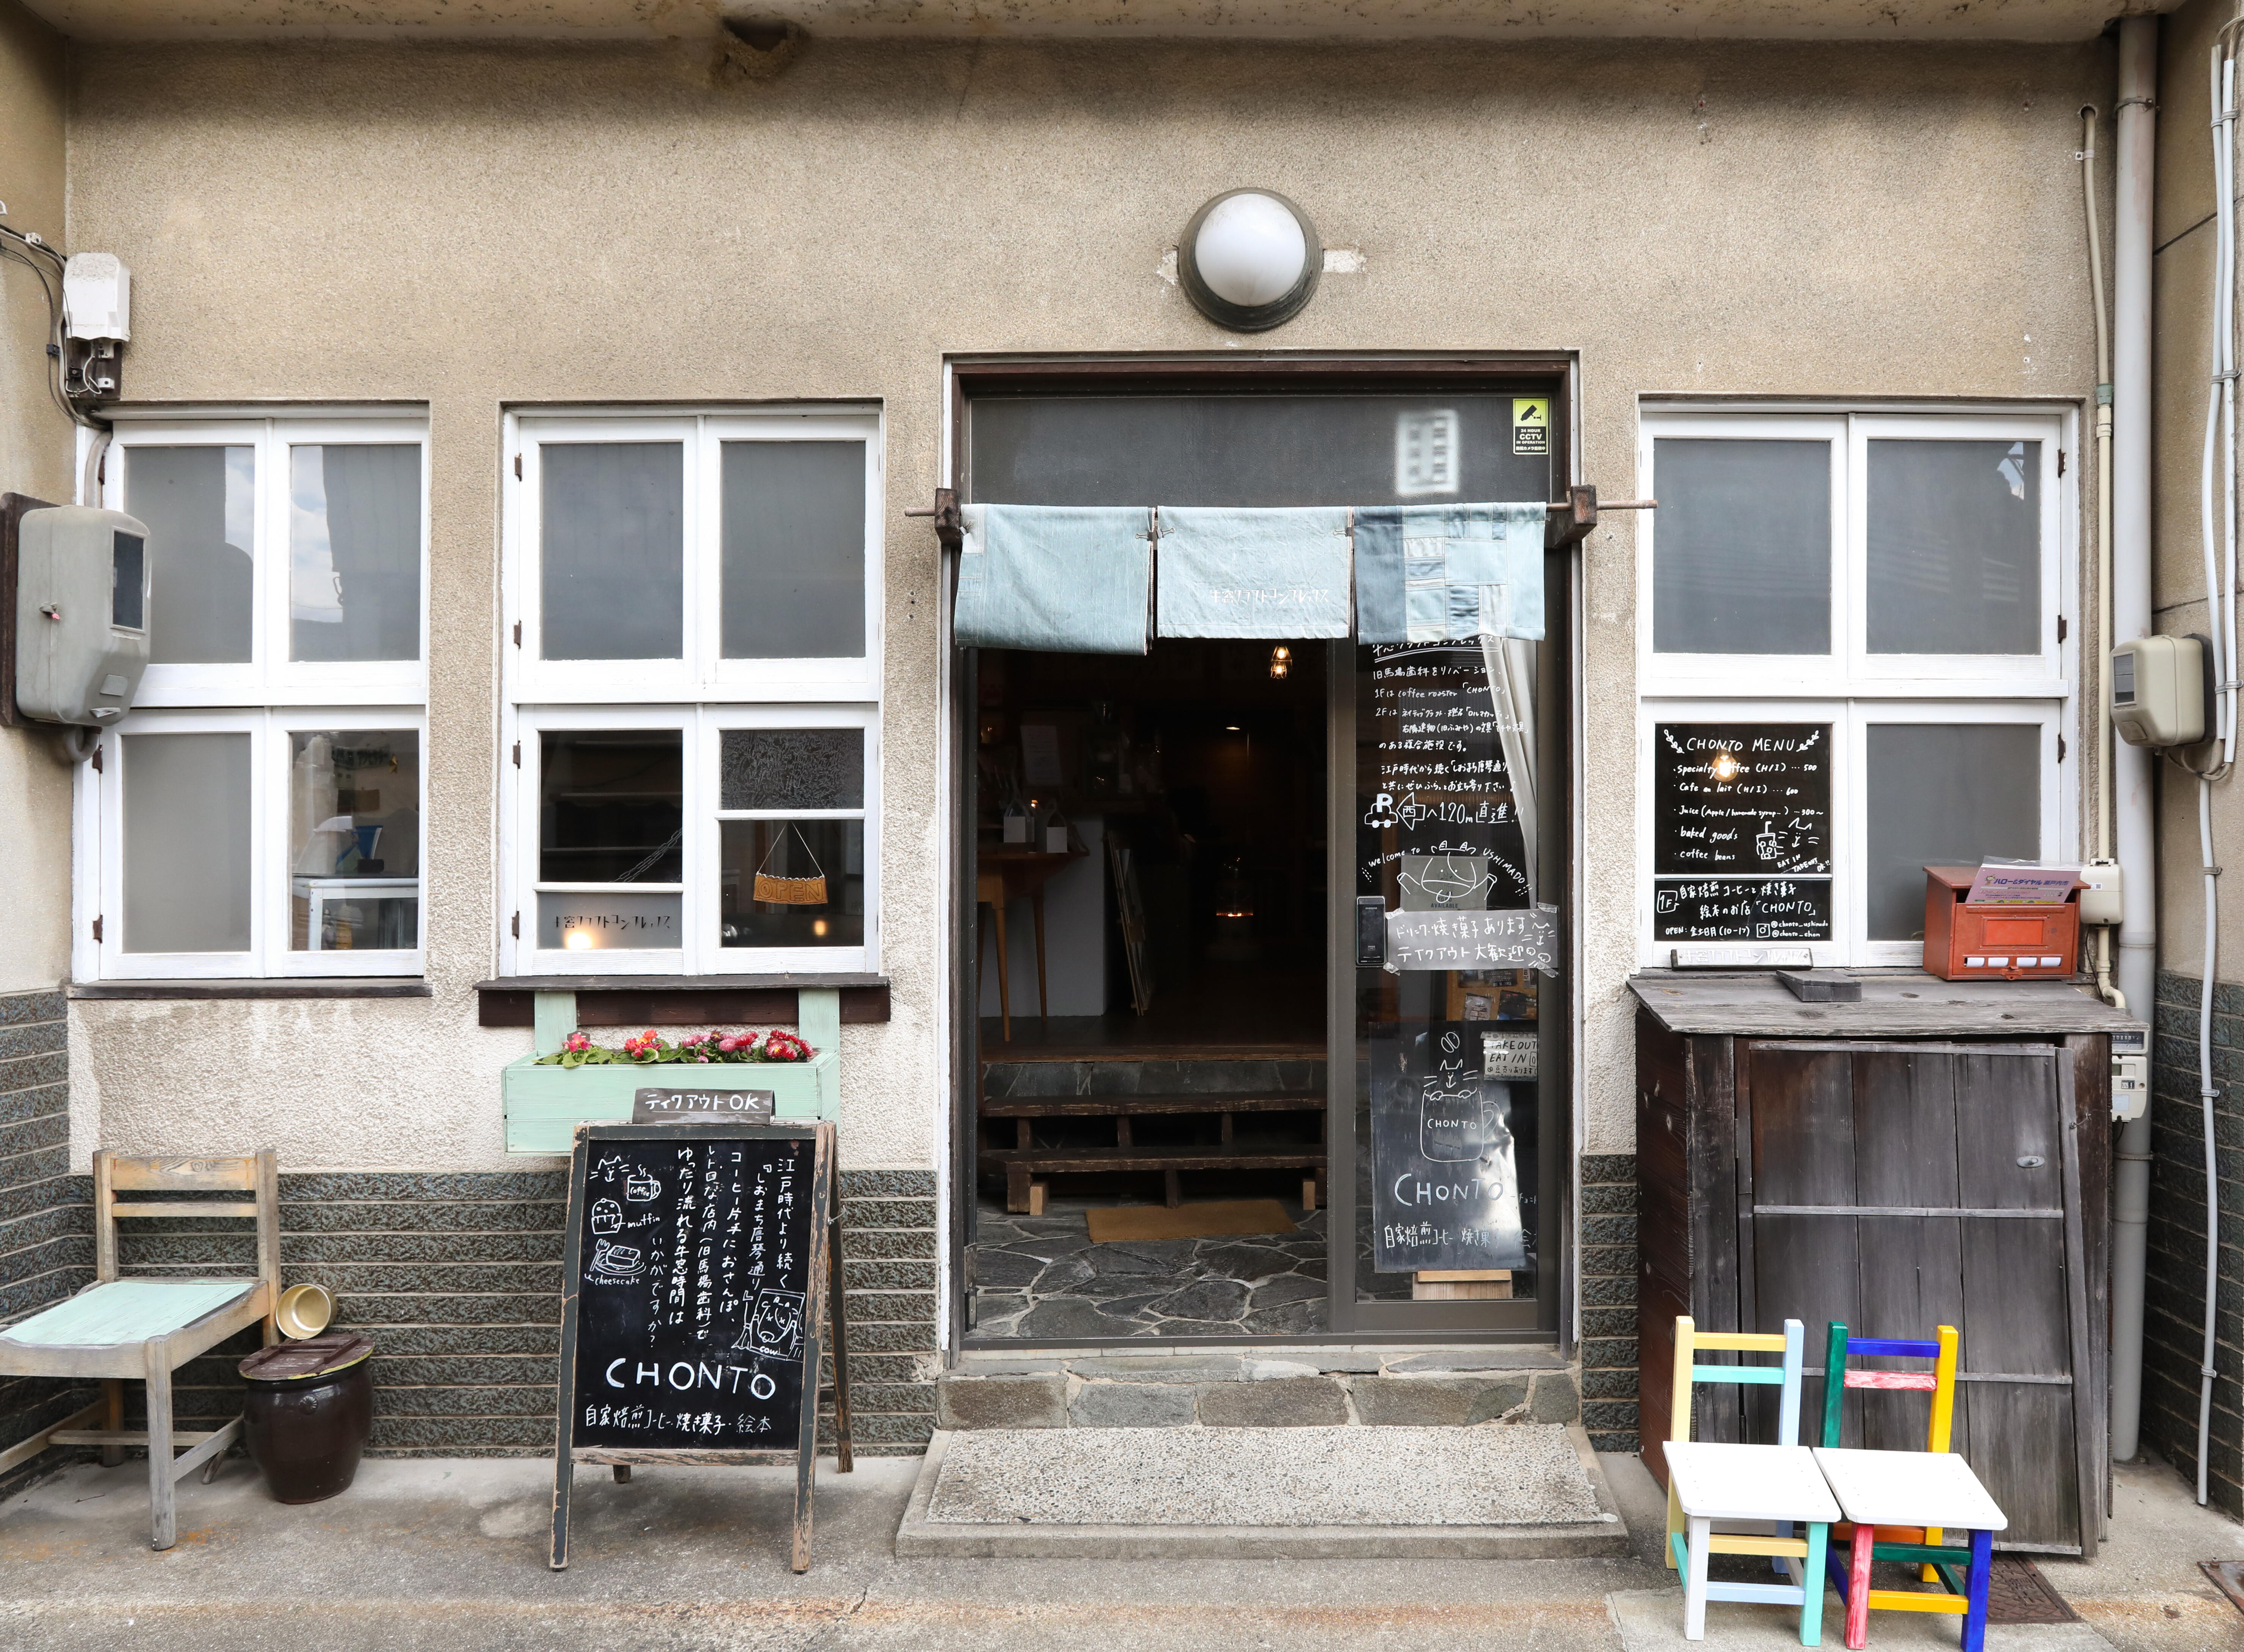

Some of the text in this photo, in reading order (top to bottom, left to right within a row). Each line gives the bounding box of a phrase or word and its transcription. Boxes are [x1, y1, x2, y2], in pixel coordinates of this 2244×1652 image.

[1209, 588, 1328, 605] 牛窓クラフトコンプレックス
[1686, 737, 1795, 752] CHONTO MENU
[1679, 782, 1699, 792] Cafe
[1716, 782, 1733, 793] lait
[1786, 787, 1798, 796] 600
[1680, 826, 1738, 843] baked goods
[1680, 848, 1735, 861] coffee beans
[1777, 854, 1801, 869] EAT IN
[759, 880, 824, 902] OPEN
[1489, 1053, 1509, 1062] EAT
[1511, 1053, 1527, 1063] IN
[729, 1092, 760, 1111] OK
[1427, 1118, 1477, 1130] CHONTO
[1394, 1173, 1504, 1206] CHONTO
[627, 1213, 660, 1228] muffin
[776, 1158, 795, 1289] 江戸時代より続く
[595, 1274, 640, 1285] cheesecake
[606, 1357, 776, 1400] CHONTO
